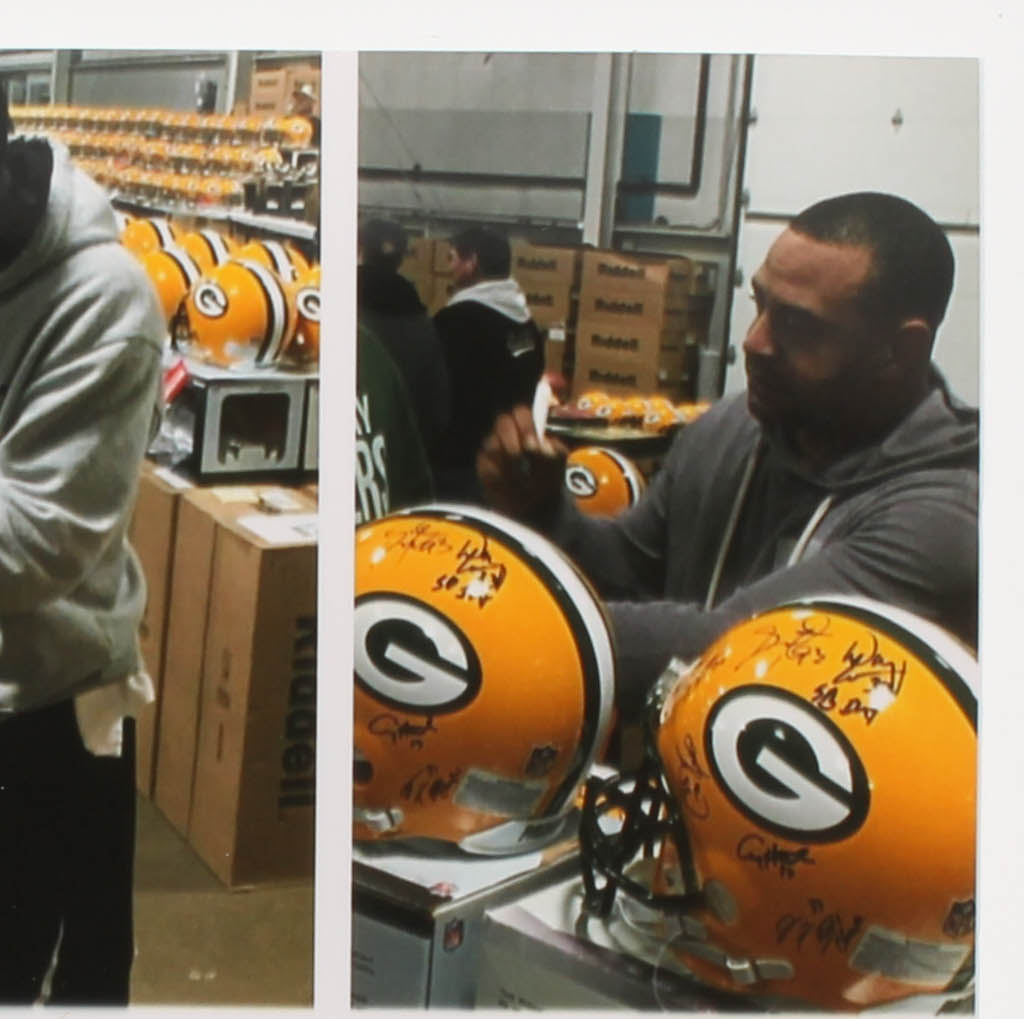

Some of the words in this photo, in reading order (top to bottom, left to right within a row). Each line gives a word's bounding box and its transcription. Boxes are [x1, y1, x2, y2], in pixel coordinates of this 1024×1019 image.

[594, 298, 644, 316] Riddell
[591, 333, 639, 351] Riddell
[588, 369, 637, 388] Riddell
[354, 600, 469, 707] G
[711, 695, 854, 832] G
